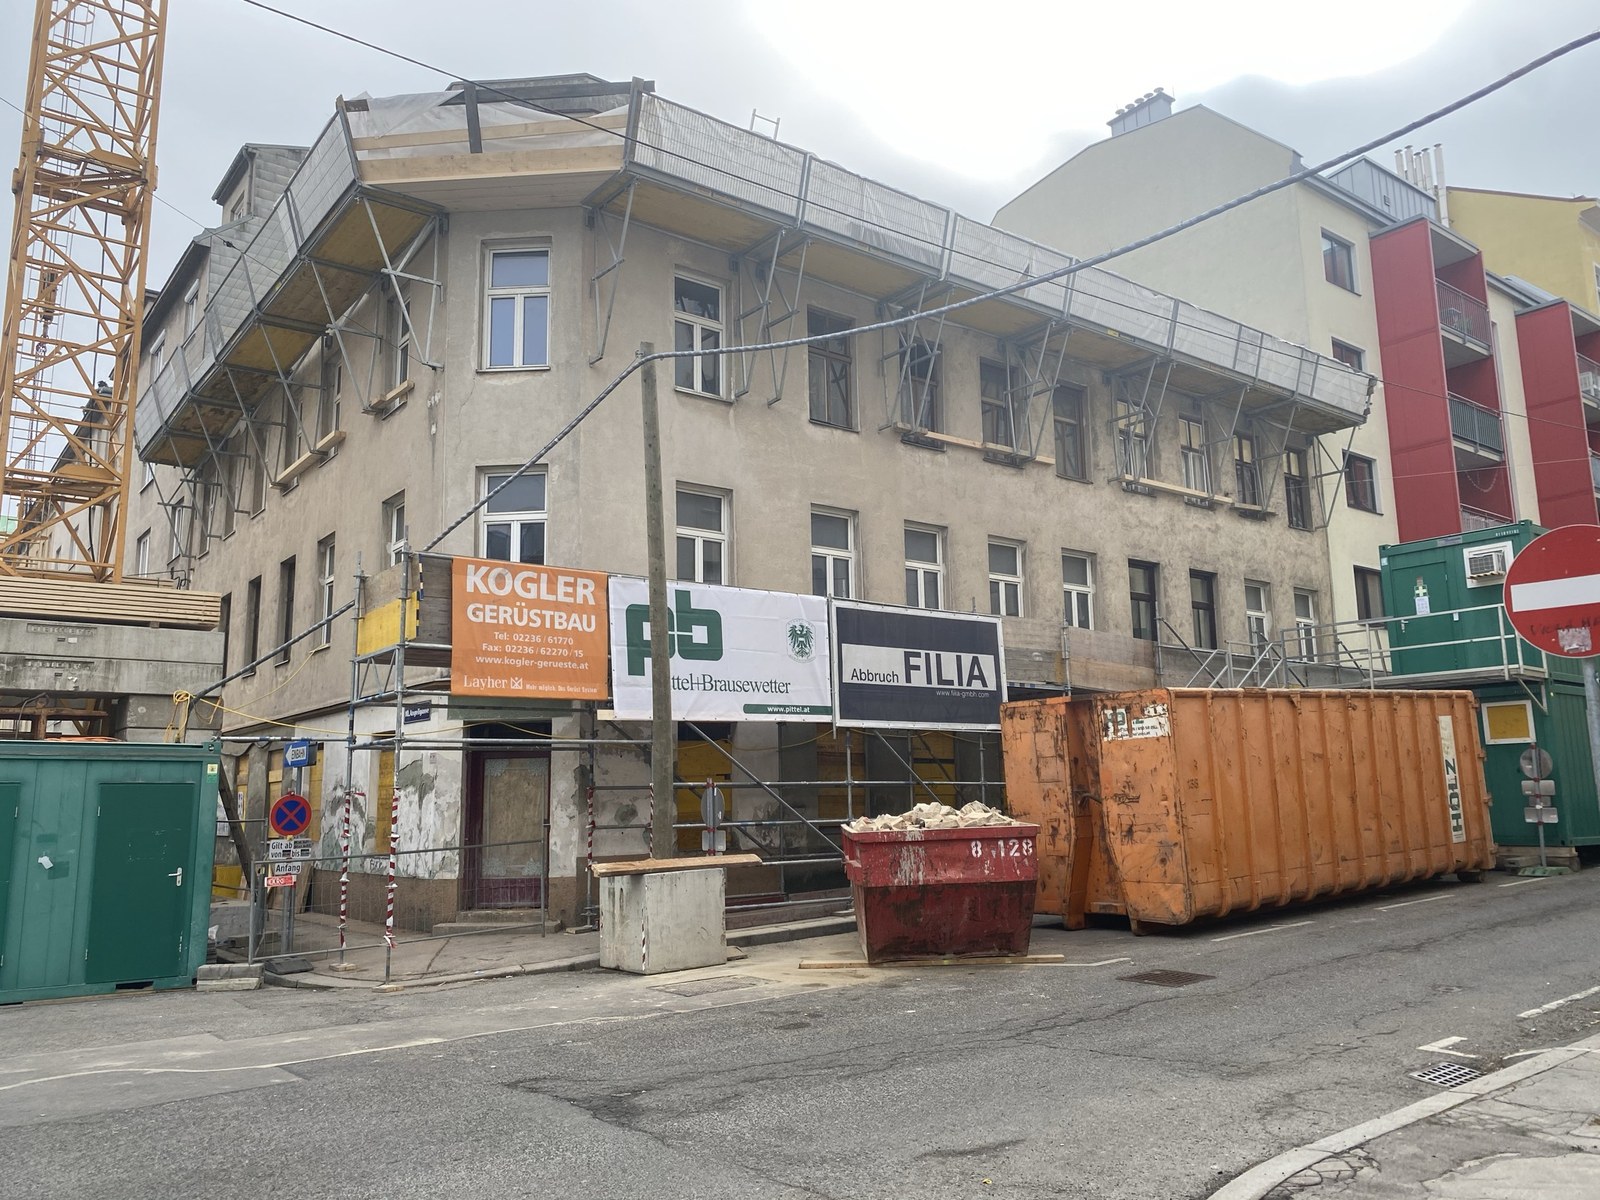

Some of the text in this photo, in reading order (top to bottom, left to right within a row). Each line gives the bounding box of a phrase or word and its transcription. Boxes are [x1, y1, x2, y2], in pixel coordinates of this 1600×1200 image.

[466, 564, 596, 605] KOGLER
[466, 602, 596, 633] GERÜSTBAU
[494, 631, 509, 641] Tel:
[482, 643, 502, 652] Fax:
[475, 656, 589, 670] www.kogler-gerueste.at
[851, 651, 988, 688] Abbruch FILIA
[463, 675, 508, 690] Layher
[671, 673, 791, 694] ttel+Brausewetter
[767, 706, 811, 714] www.pittel.at
[285, 841, 293, 849] ab
[275, 863, 300, 873] Anfang
